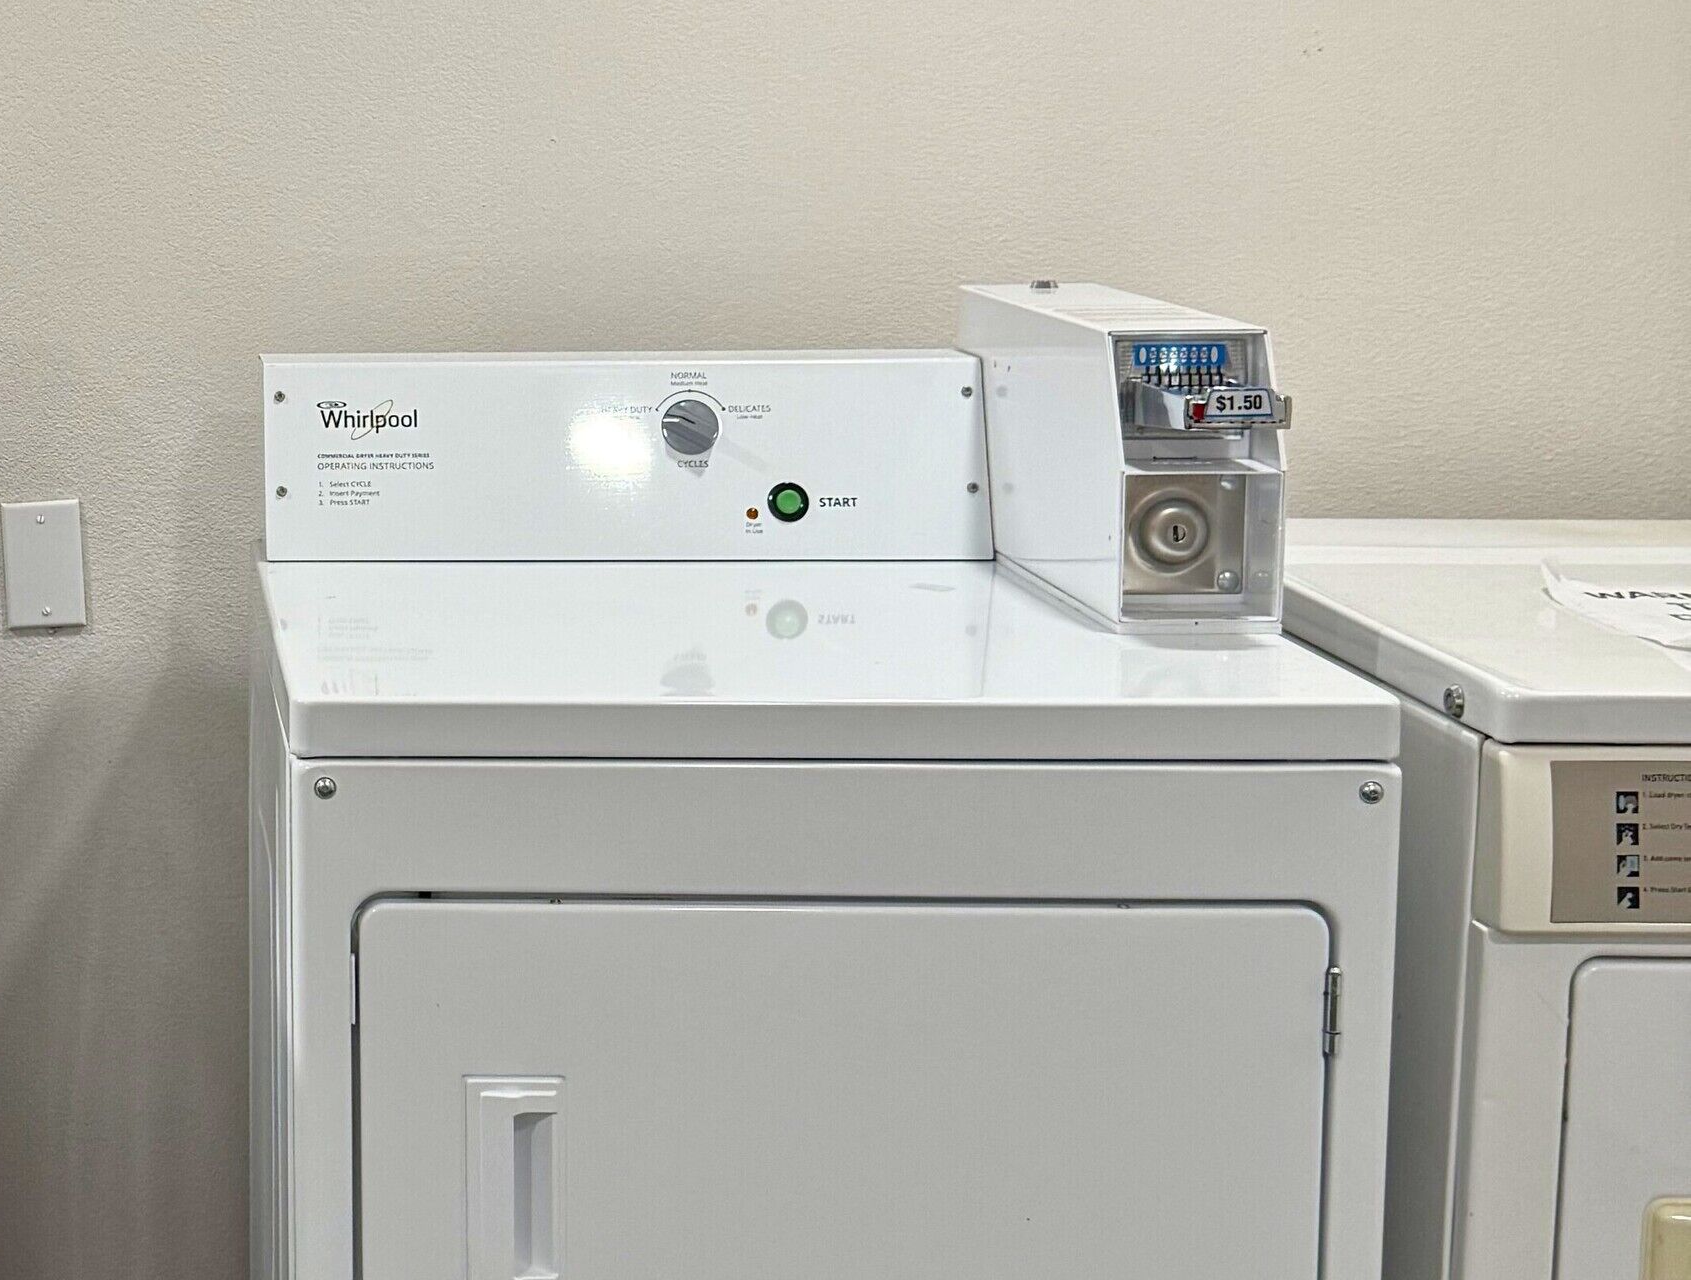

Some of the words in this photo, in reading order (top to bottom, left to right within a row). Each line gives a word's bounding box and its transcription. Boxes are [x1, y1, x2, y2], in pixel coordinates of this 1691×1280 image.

[1216, 394, 1263, 412] $1.50
[728, 405, 771, 413] DELICATES
[320, 409, 418, 434] Whirlpool
[317, 462, 367, 470] OPERATING
[369, 462, 435, 470] INSTRUCTIONS
[677, 460, 709, 468] CYCLES
[819, 497, 858, 507] START
